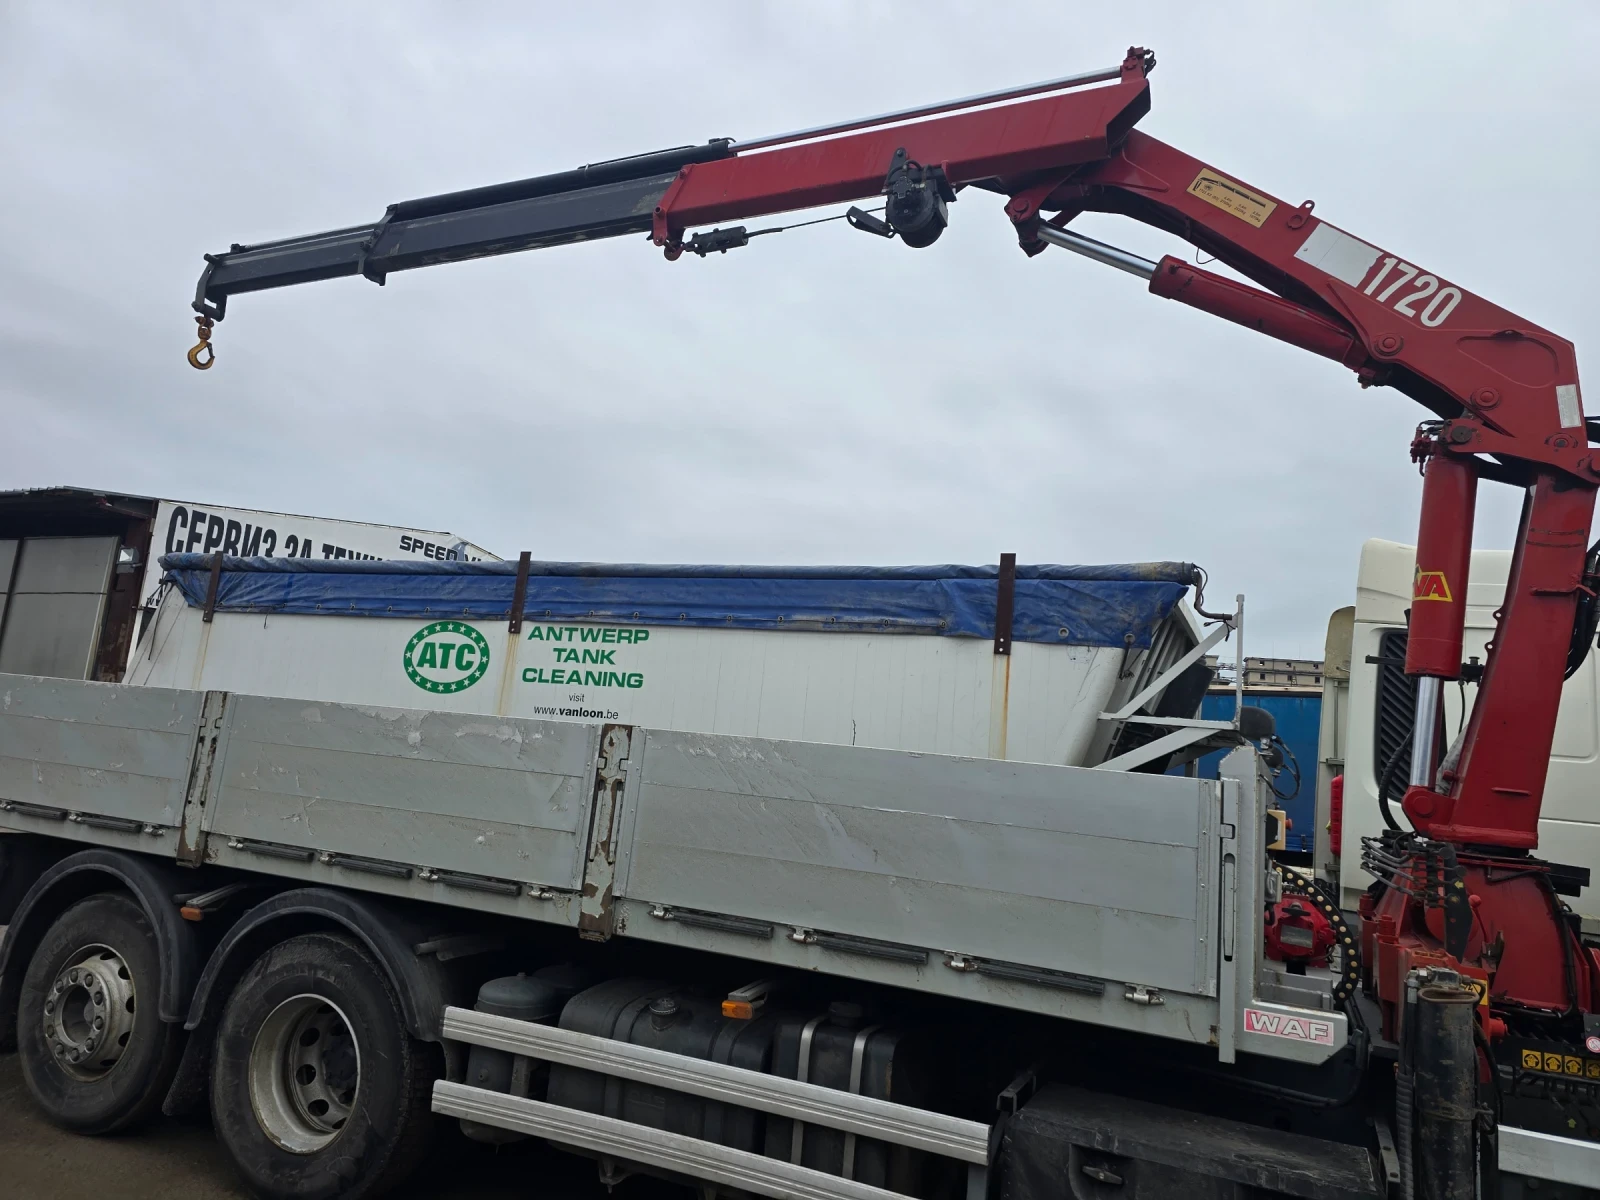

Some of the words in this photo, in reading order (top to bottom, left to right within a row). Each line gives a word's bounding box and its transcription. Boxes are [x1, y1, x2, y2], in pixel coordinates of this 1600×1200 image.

[1363, 257, 1462, 327] 1720
[528, 626, 650, 644] ANTWERP
[416, 642, 476, 671] ATC
[553, 647, 616, 665] TANK
[522, 668, 644, 689] CLEANING
[568, 693, 585, 703] visit
[533, 705, 619, 720] www.vanloon.be
[1250, 1012, 1328, 1039] WAF
